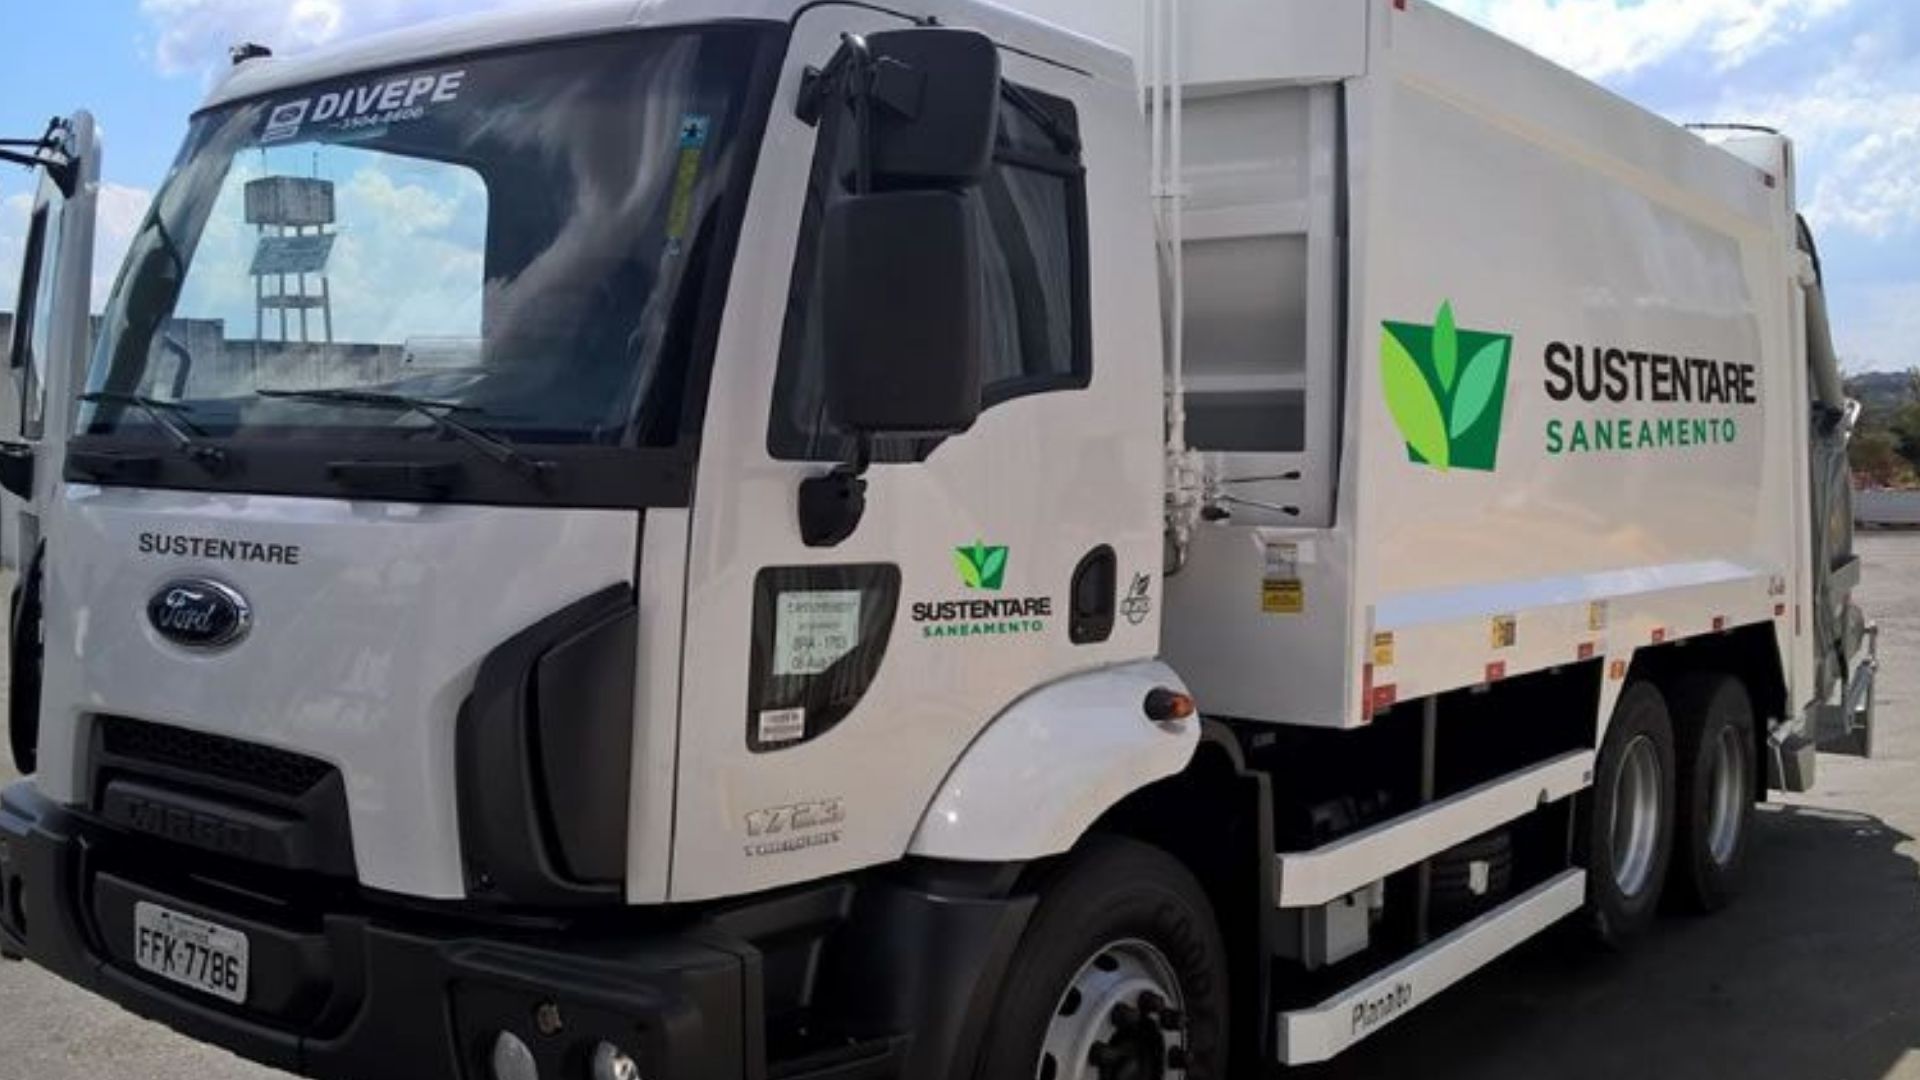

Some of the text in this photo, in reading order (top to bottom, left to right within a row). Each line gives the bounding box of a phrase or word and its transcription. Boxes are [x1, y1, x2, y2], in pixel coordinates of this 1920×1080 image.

[311, 70, 466, 122] DIVEPE
[1544, 340, 1757, 404] SUSTENTARE
[1546, 418, 1736, 453] SANEAMENTO
[138, 532, 300, 565] SUSTENTARE
[158, 588, 217, 632] Ford
[912, 596, 1052, 622] SUSTENTARE
[922, 620, 1044, 638] SANEAMENTO
[140, 926, 240, 992] FFK-7786
